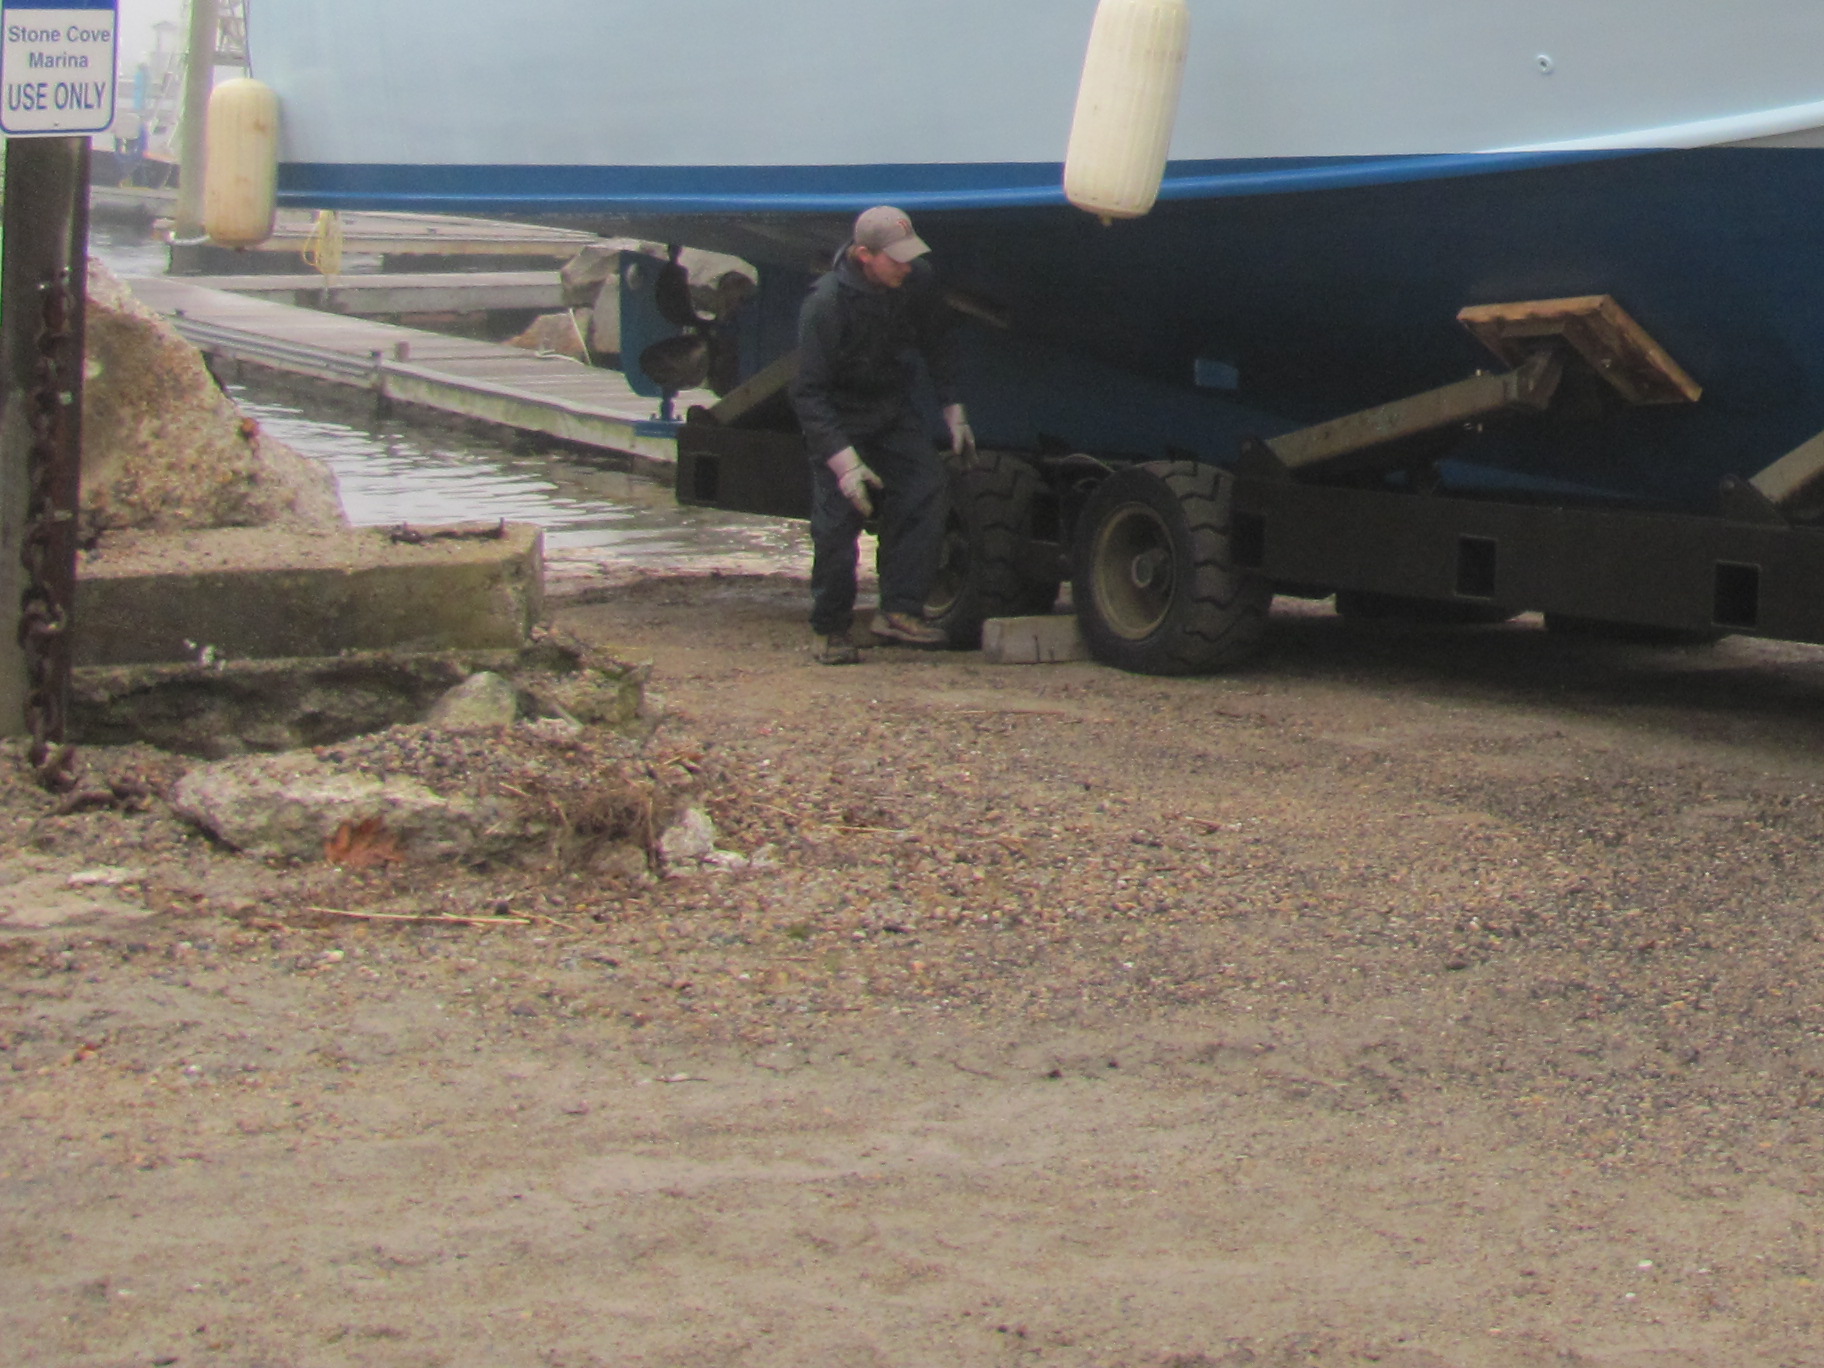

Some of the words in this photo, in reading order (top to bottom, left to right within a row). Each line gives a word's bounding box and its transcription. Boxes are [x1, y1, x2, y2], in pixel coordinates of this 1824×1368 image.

[8, 25, 61, 43] Stone
[66, 26, 111, 43] Cove
[28, 51, 88, 69] Marina
[8, 82, 48, 111] USE
[54, 81, 106, 110] ONLY
